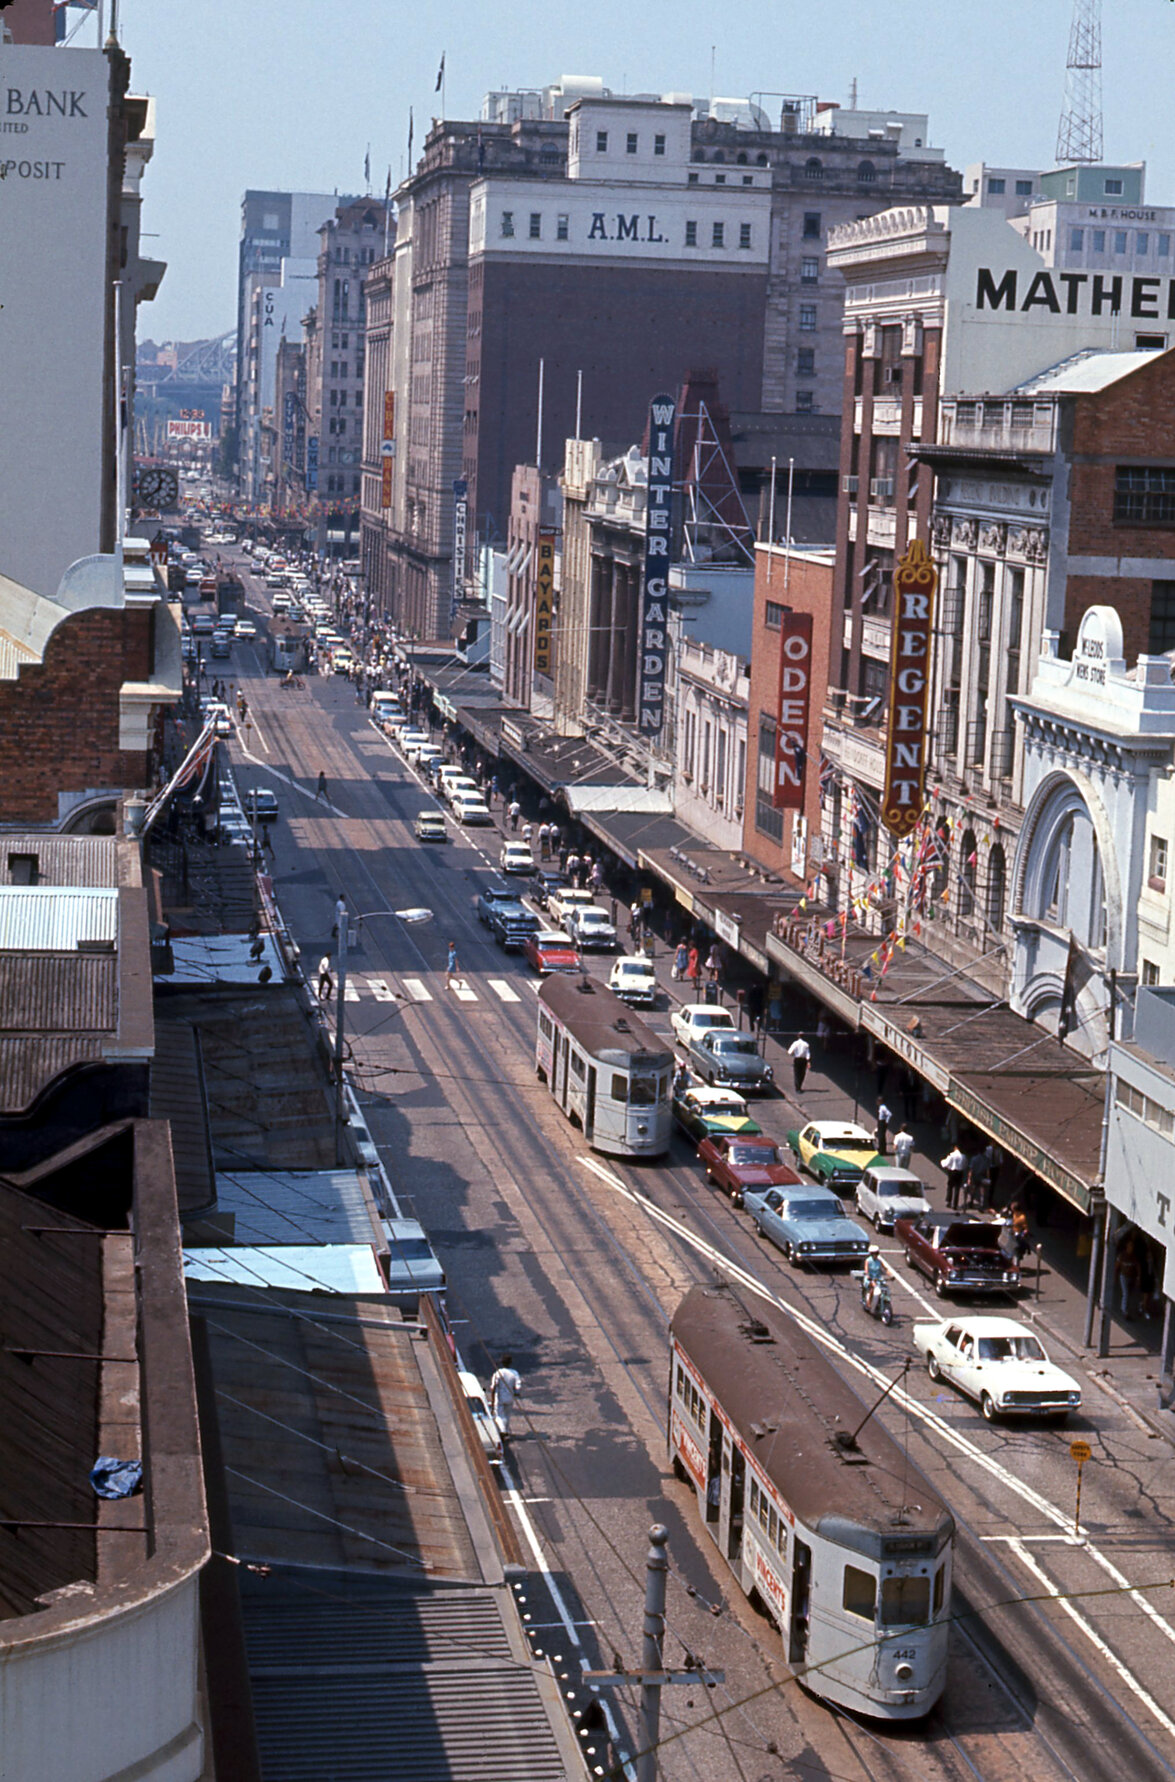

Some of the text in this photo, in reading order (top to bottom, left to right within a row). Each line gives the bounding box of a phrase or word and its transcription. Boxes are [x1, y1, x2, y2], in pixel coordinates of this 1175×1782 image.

[6, 88, 89, 118] BANK
[0, 122, 29, 134] ITED
[0, 160, 66, 180] POSIT
[1120, 210, 1156, 221] HOUSE
[976, 266, 1175, 321] MATHE
[169, 422, 201, 436] PHILIPS
[455, 505, 466, 599] CHRISTIES
[640, 403, 676, 728] WINTER GARDEN
[536, 545, 552, 669] BAYARDS
[1090, 665, 1106, 687] STORE
[777, 634, 808, 786] ODEON
[891, 591, 929, 806] REGENT
[954, 1085, 994, 1127] BRITISH
[1042, 1158, 1080, 1199] HOTEL
[892, 1649, 916, 1660] 442
